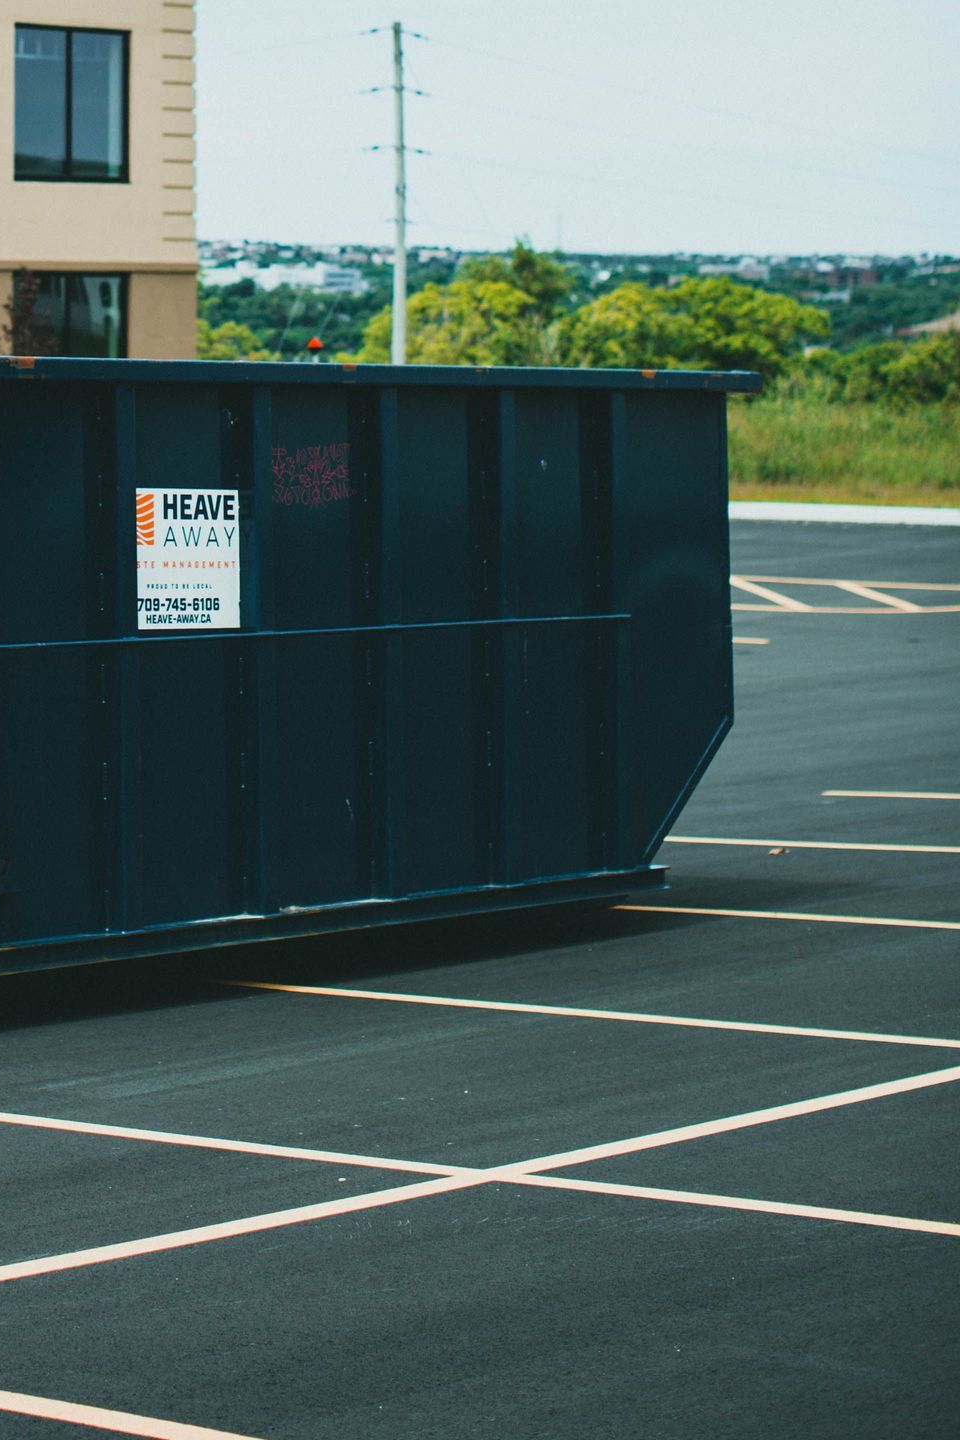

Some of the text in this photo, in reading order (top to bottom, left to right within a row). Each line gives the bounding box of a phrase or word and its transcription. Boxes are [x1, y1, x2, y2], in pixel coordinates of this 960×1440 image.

[163, 493, 235, 520] HEAVE
[163, 526, 235, 547] AWAY
[163, 561, 236, 569] MANAGEMENT
[137, 598, 220, 612] 709-745-6106
[146, 614, 212, 624] HEAVE-AWAY.CA
